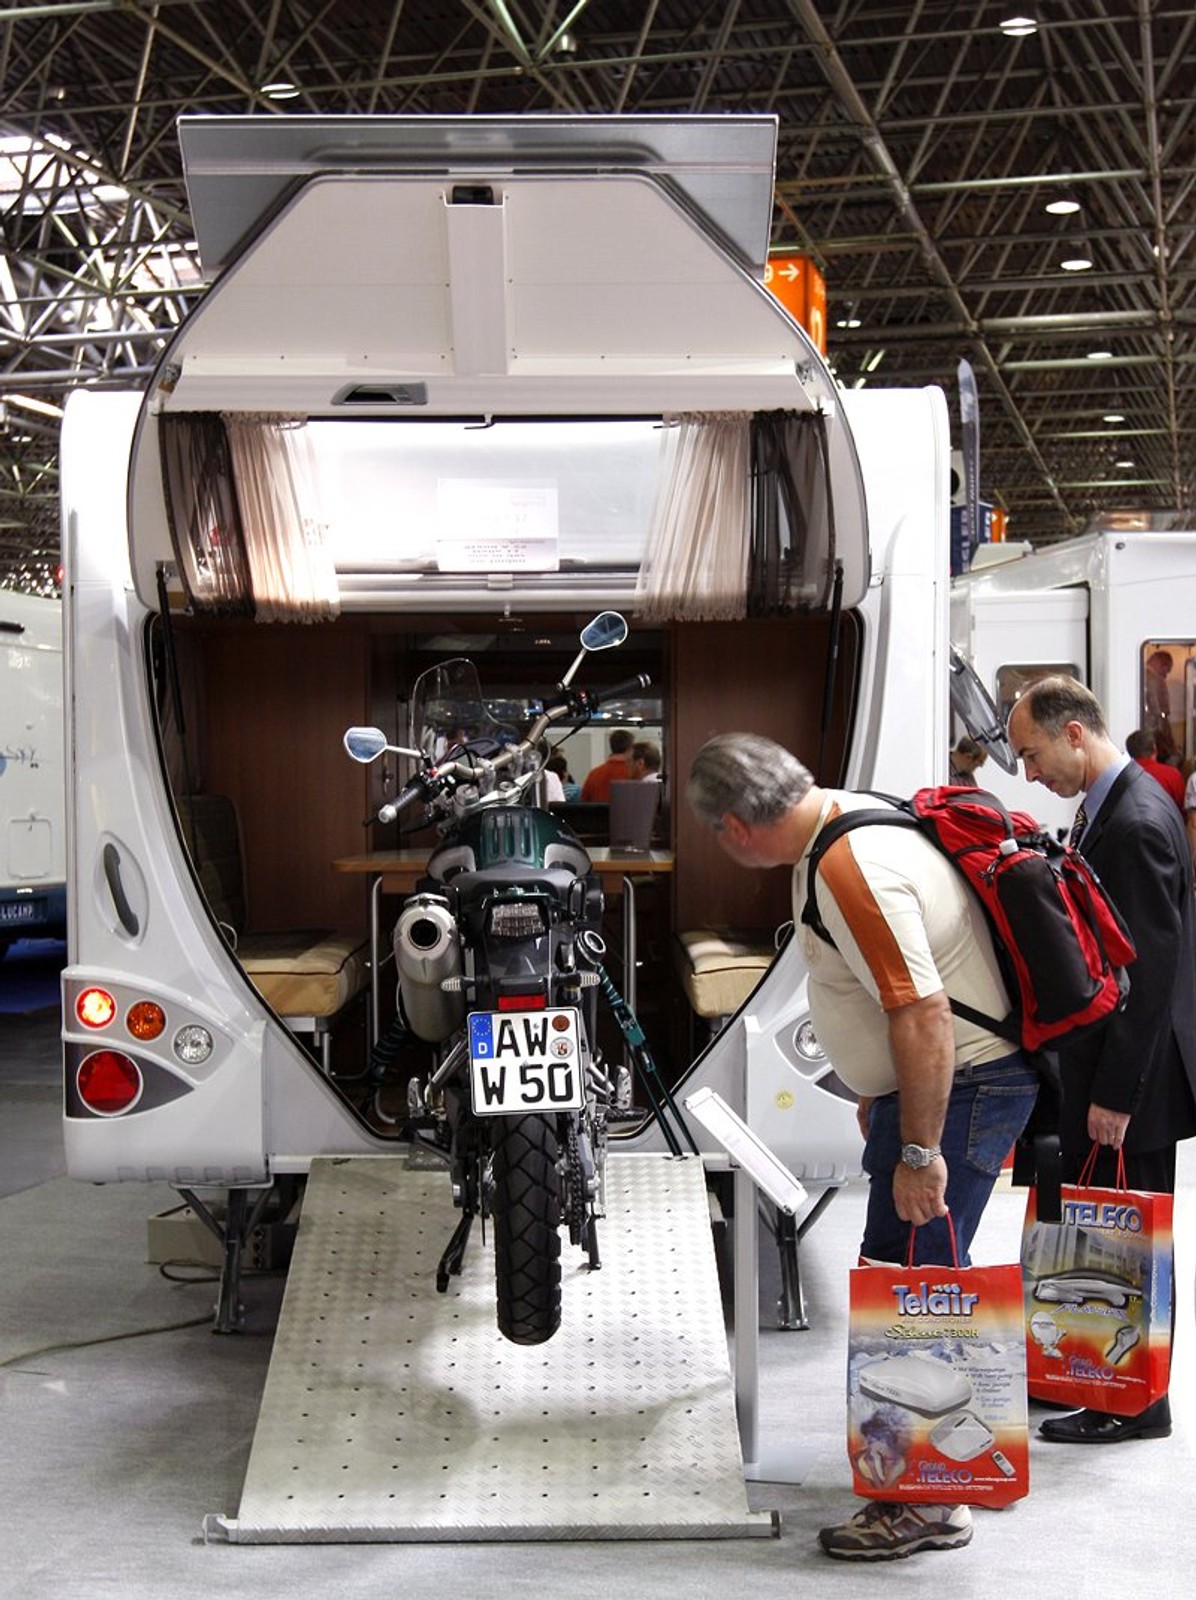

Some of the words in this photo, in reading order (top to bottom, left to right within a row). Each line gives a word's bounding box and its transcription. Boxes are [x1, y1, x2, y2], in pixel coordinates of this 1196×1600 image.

[478, 1042, 488, 1054] D
[496, 1017, 549, 1058] AW
[480, 1066, 506, 1105] W
[519, 1063, 573, 1103] 50
[1064, 1201, 1144, 1233] TELECO
[921, 1469, 973, 1484] TELECO
